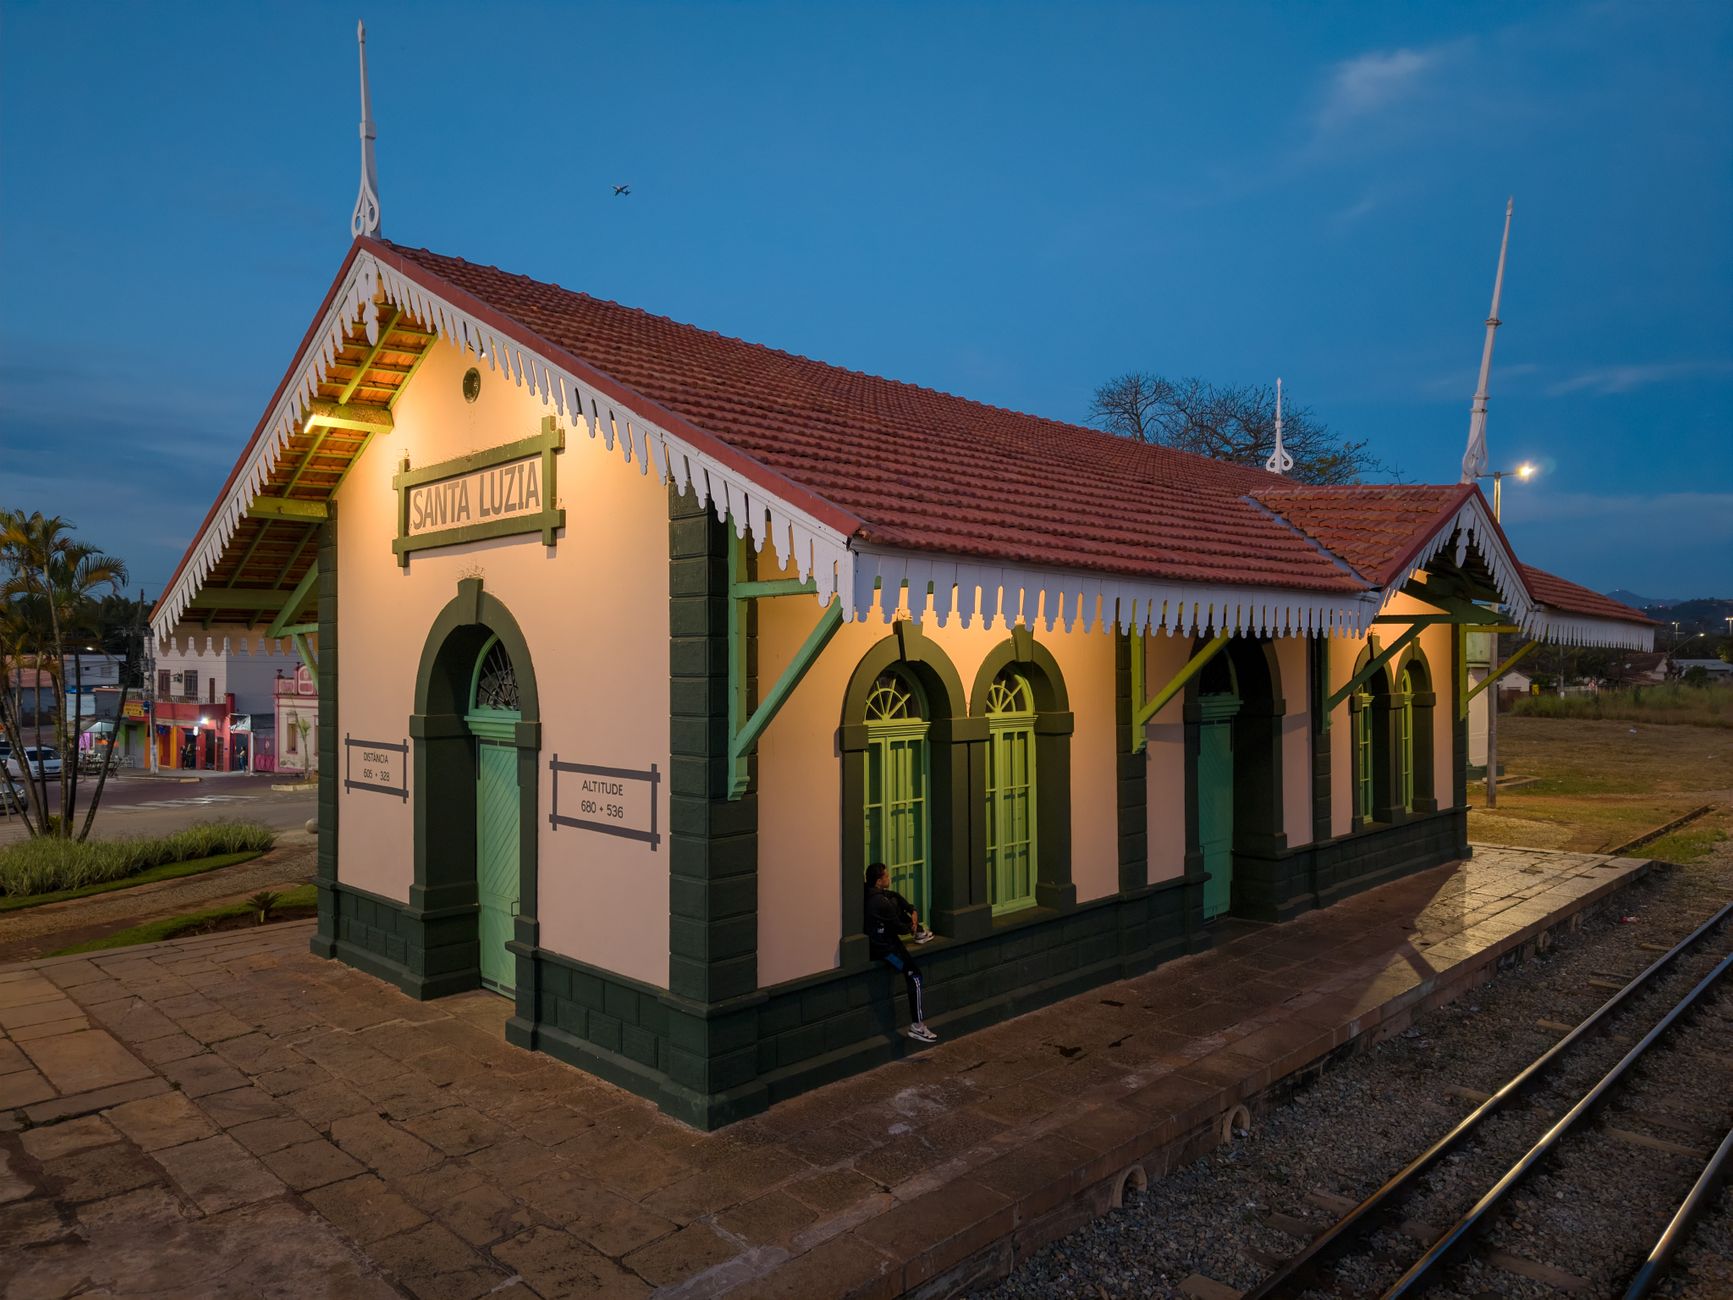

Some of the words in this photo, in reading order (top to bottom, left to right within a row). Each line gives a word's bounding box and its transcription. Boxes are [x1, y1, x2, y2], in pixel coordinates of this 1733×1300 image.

[413, 479, 470, 530] SANTA
[479, 461, 541, 518] LUZIA
[581, 779, 624, 796] ALTITUDE
[581, 799, 597, 814] 680
[606, 803, 624, 819] 536
